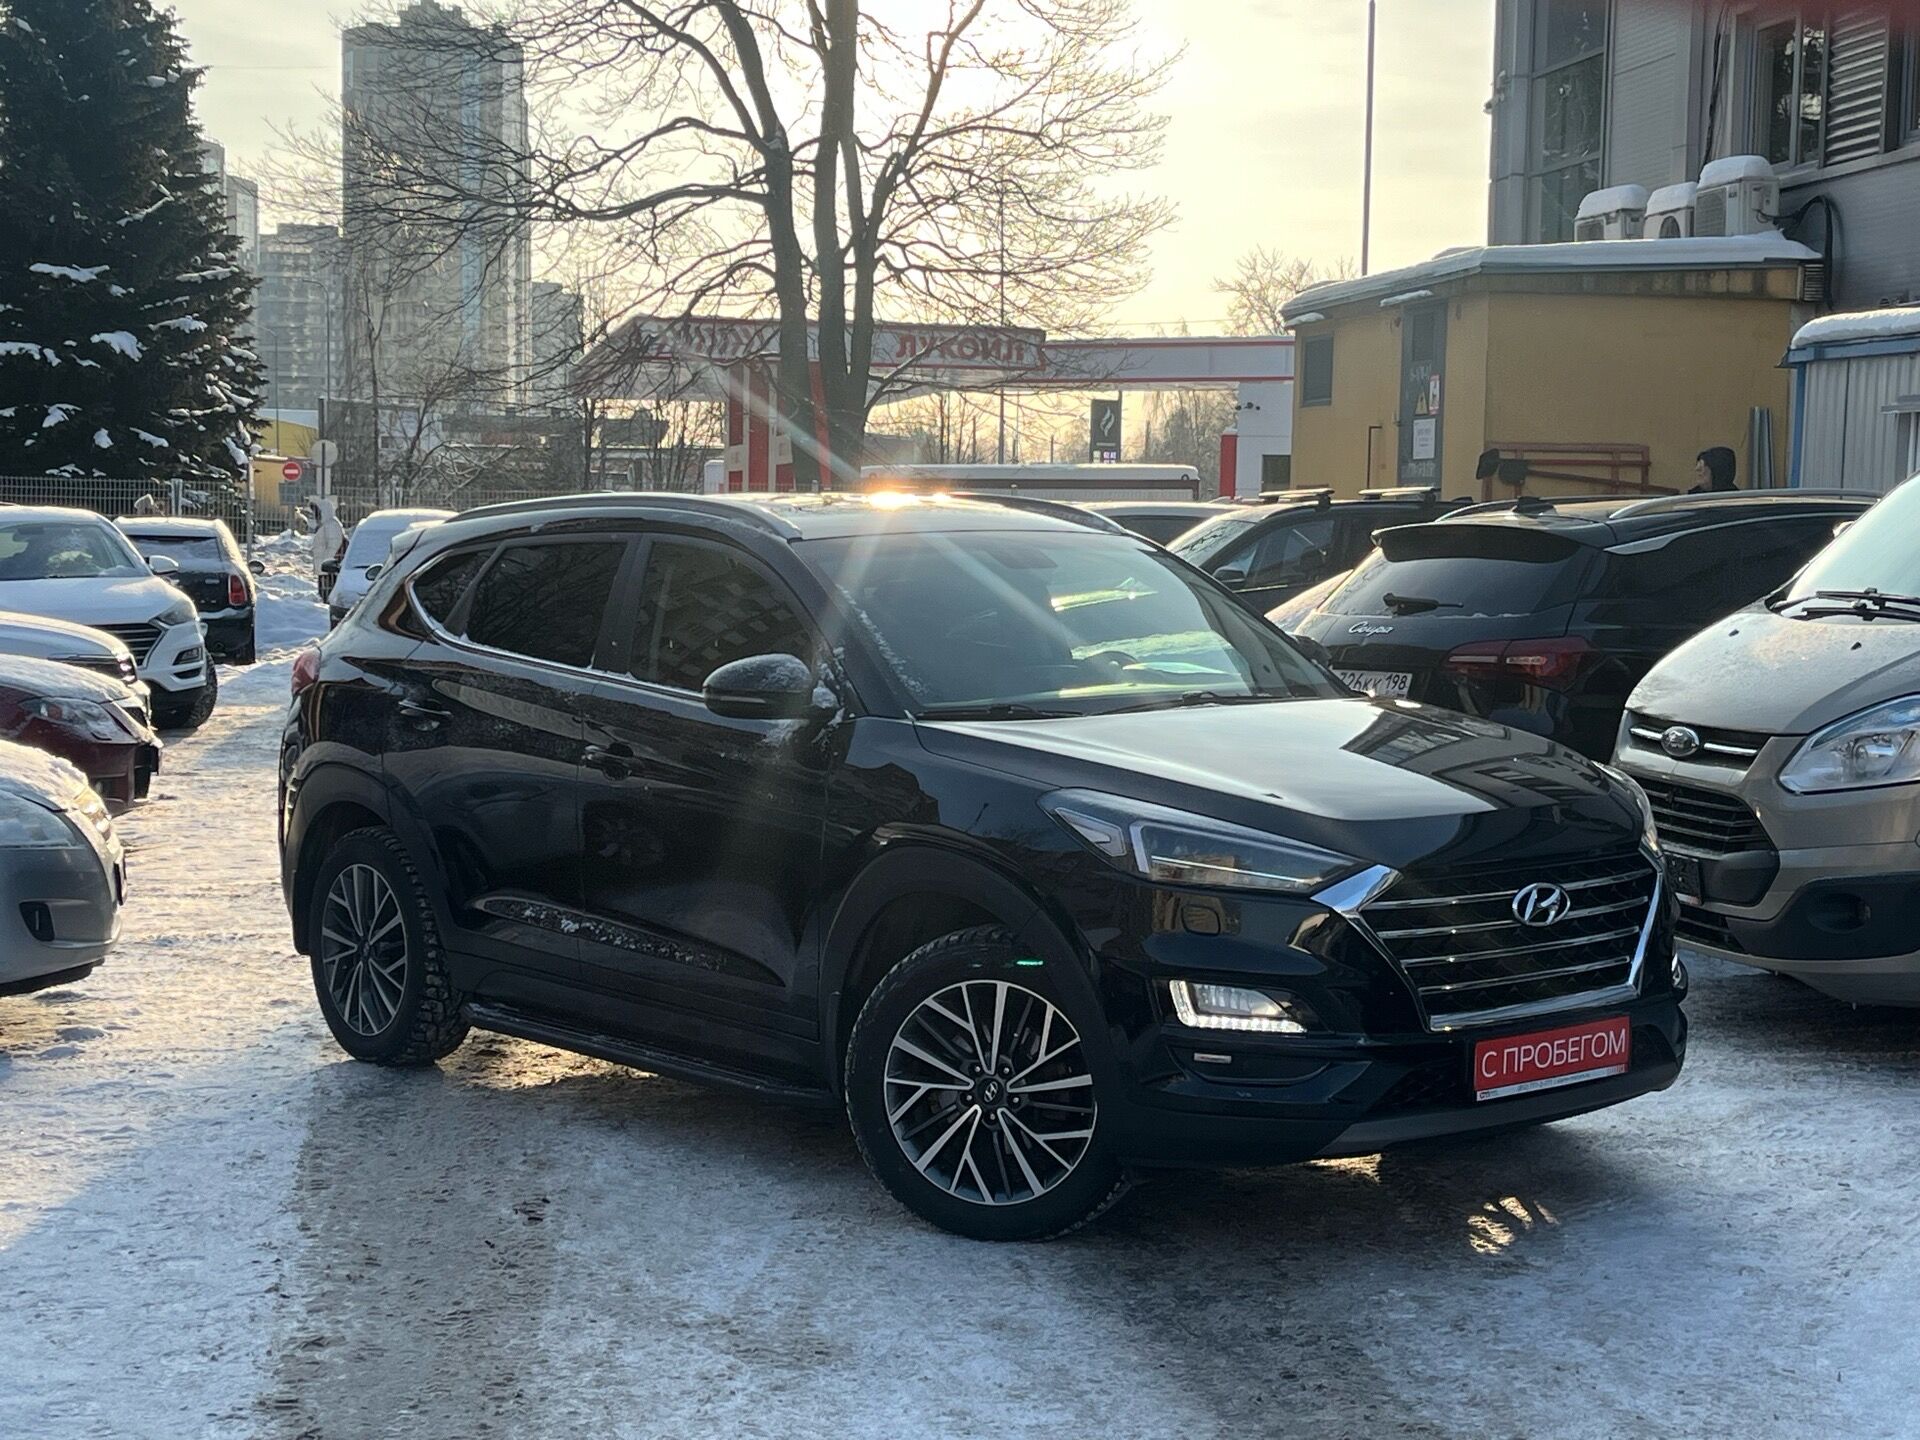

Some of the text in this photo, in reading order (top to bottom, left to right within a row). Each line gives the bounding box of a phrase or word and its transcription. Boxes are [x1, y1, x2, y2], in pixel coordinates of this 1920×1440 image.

[1385, 673, 1408, 690] 198
[1481, 1028, 1626, 1078] С ПРОБЕГОМ
